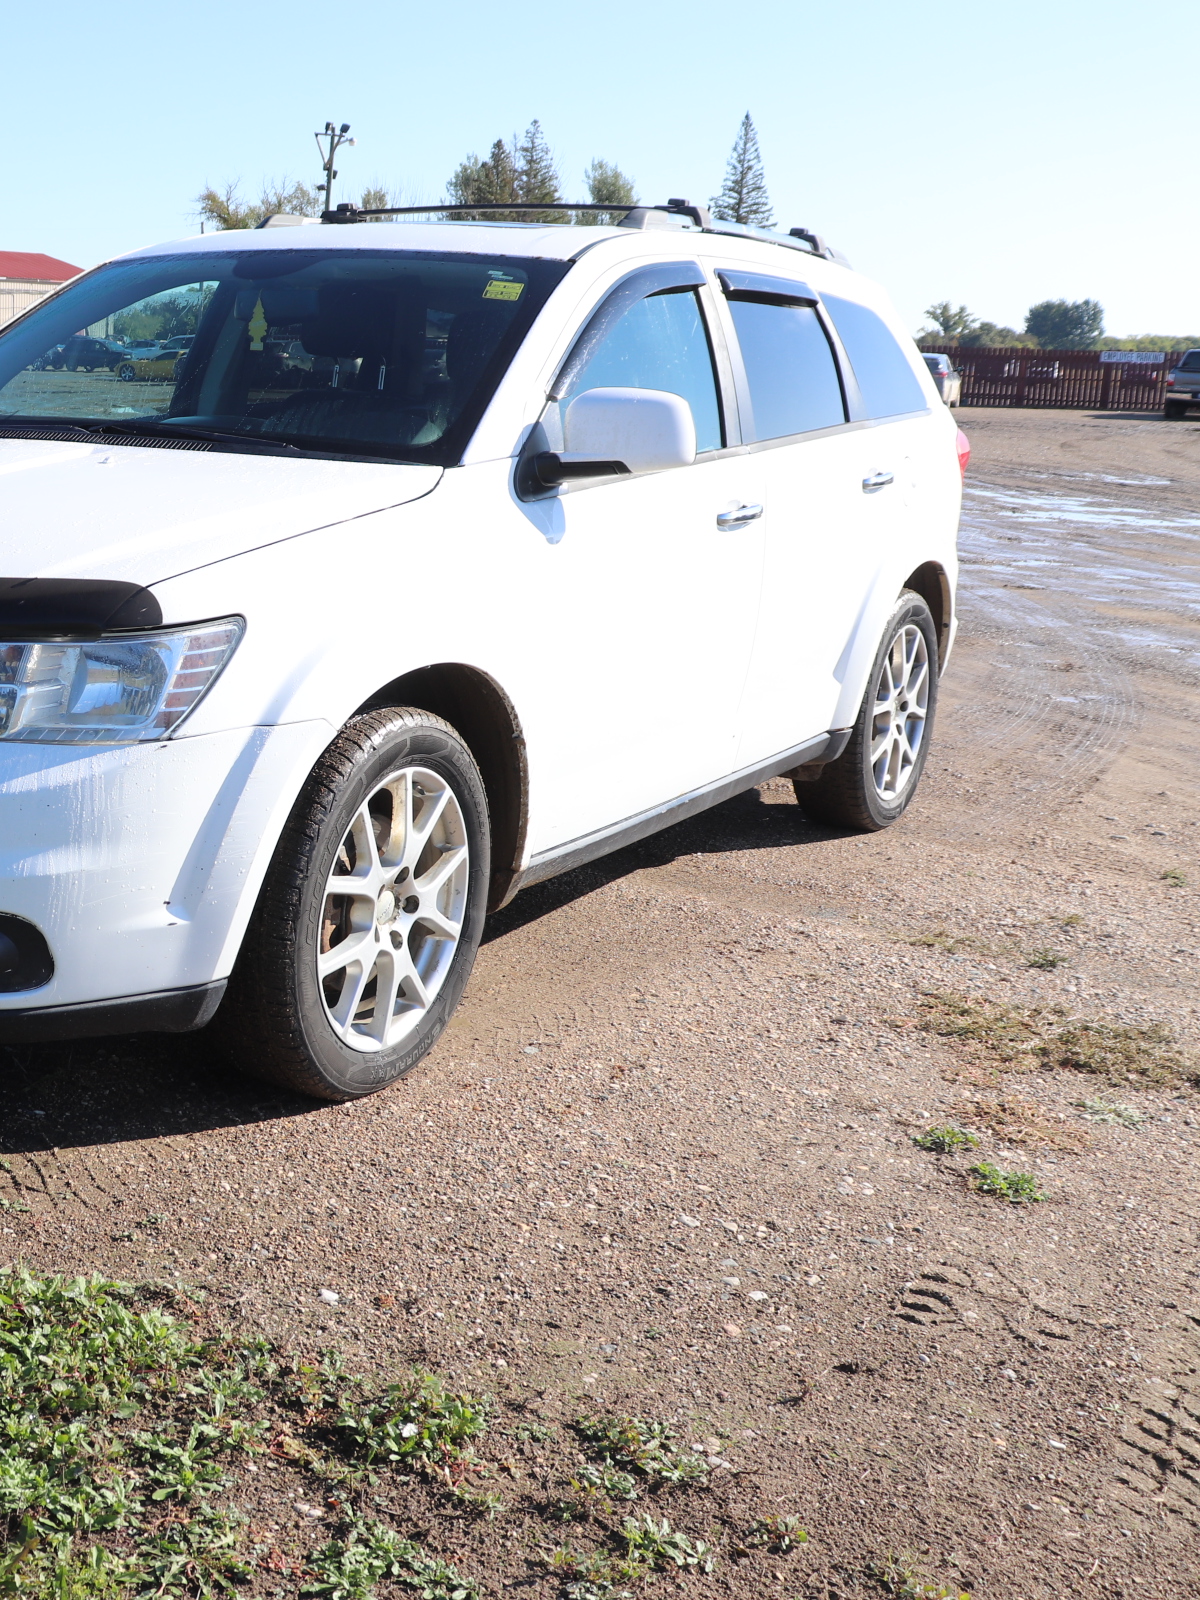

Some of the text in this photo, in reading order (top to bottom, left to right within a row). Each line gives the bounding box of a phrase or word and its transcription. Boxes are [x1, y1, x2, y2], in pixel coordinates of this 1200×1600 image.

[1103, 351, 1163, 362] EMPLOYEE PARKING
[305, 809, 348, 946] COOPER
